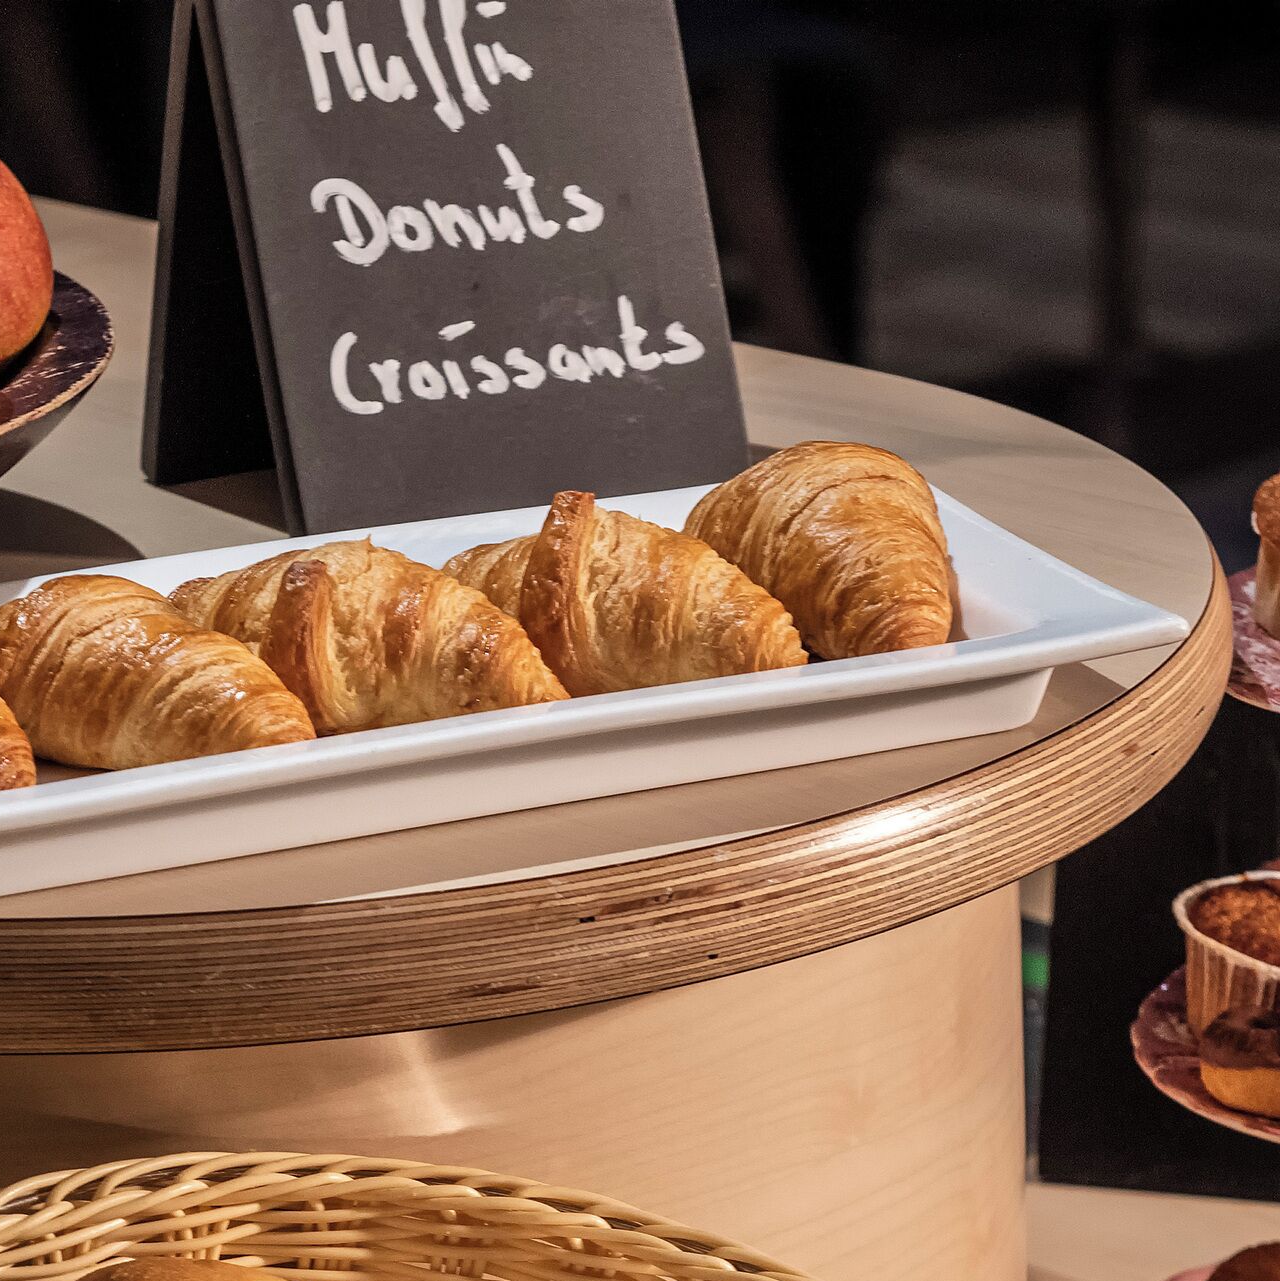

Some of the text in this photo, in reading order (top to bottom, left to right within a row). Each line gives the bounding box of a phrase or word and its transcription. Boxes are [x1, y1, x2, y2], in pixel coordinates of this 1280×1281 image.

[293, 0, 533, 132] Muffin
[311, 144, 604, 266] Donuts
[331, 295, 705, 414] Croissants
